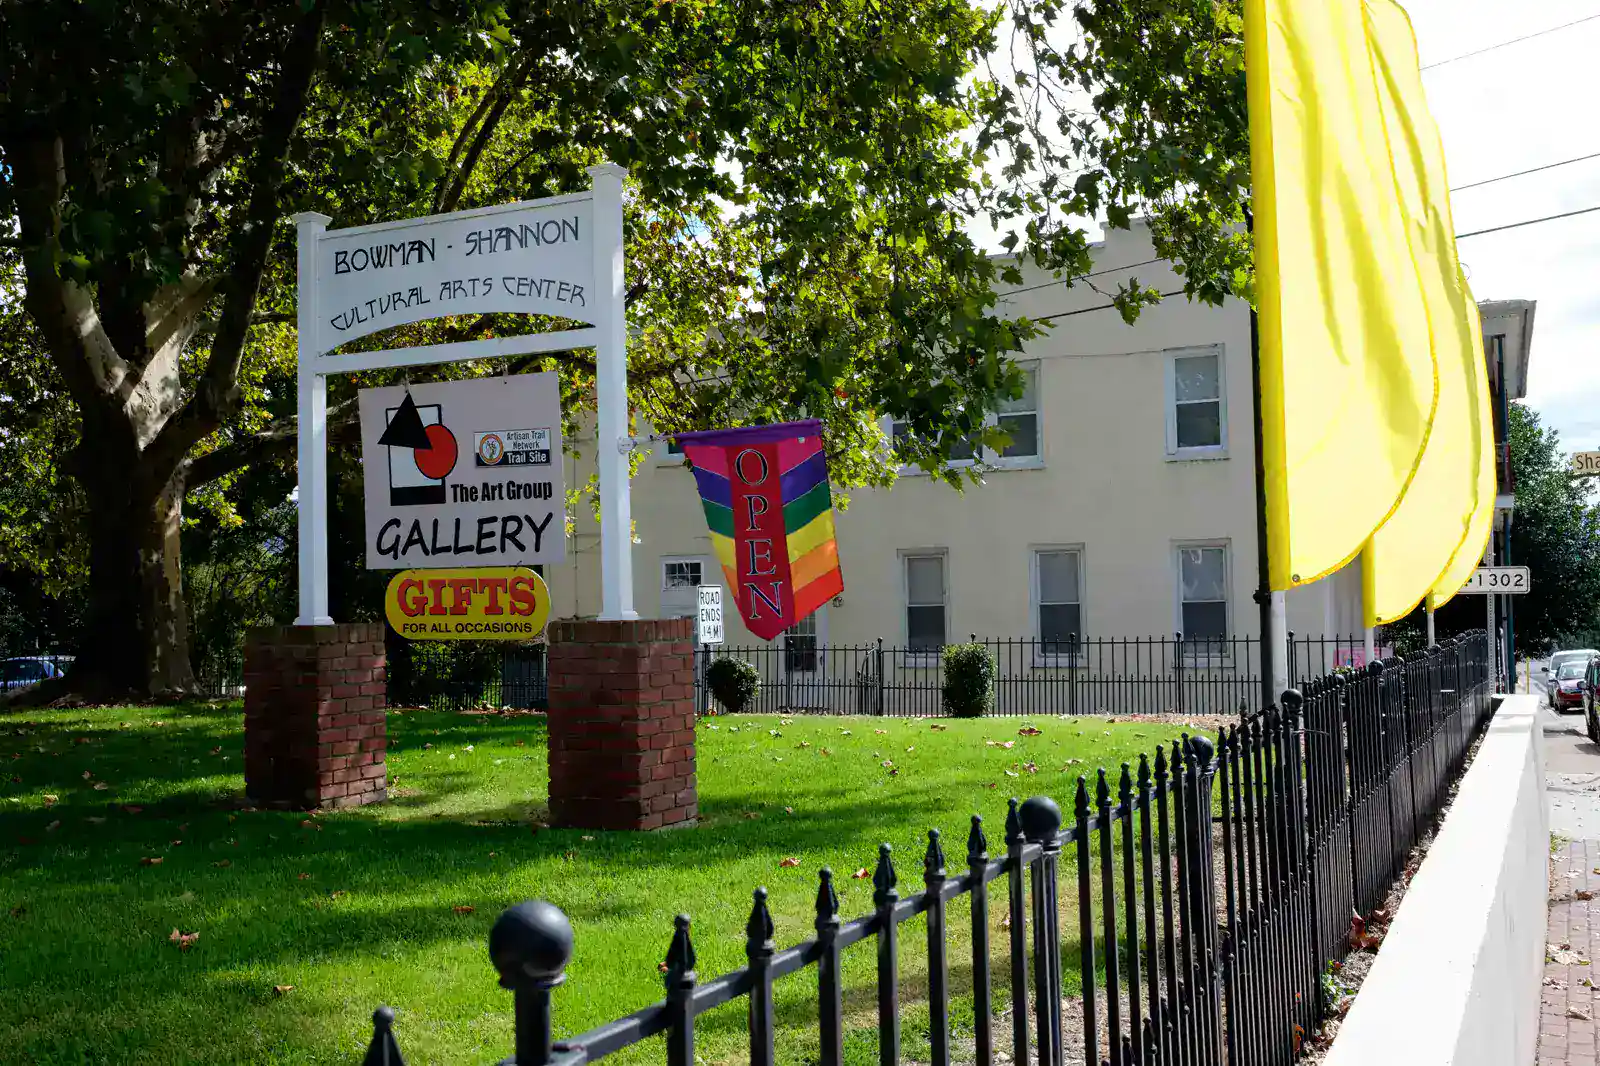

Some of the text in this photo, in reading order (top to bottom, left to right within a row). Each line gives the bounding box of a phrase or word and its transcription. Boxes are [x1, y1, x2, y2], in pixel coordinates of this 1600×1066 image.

[335, 238, 436, 275] BOWMAN
[466, 216, 579, 256] SHANNON
[331, 276, 585, 331] CULTURAL ARTS CENTER
[507, 431, 546, 441] Artisan Trail
[513, 441, 540, 450] Network
[507, 451, 546, 464] Trail Site
[451, 481, 552, 502] The Art Group
[376, 512, 554, 560] GALLERY
[735, 448, 783, 620] OPEN
[397, 576, 536, 617] GIFTS
[700, 592, 720, 605] ROAD
[701, 608, 720, 622] ENDS
[403, 622, 533, 634] FOR ALL OCCASIONS
